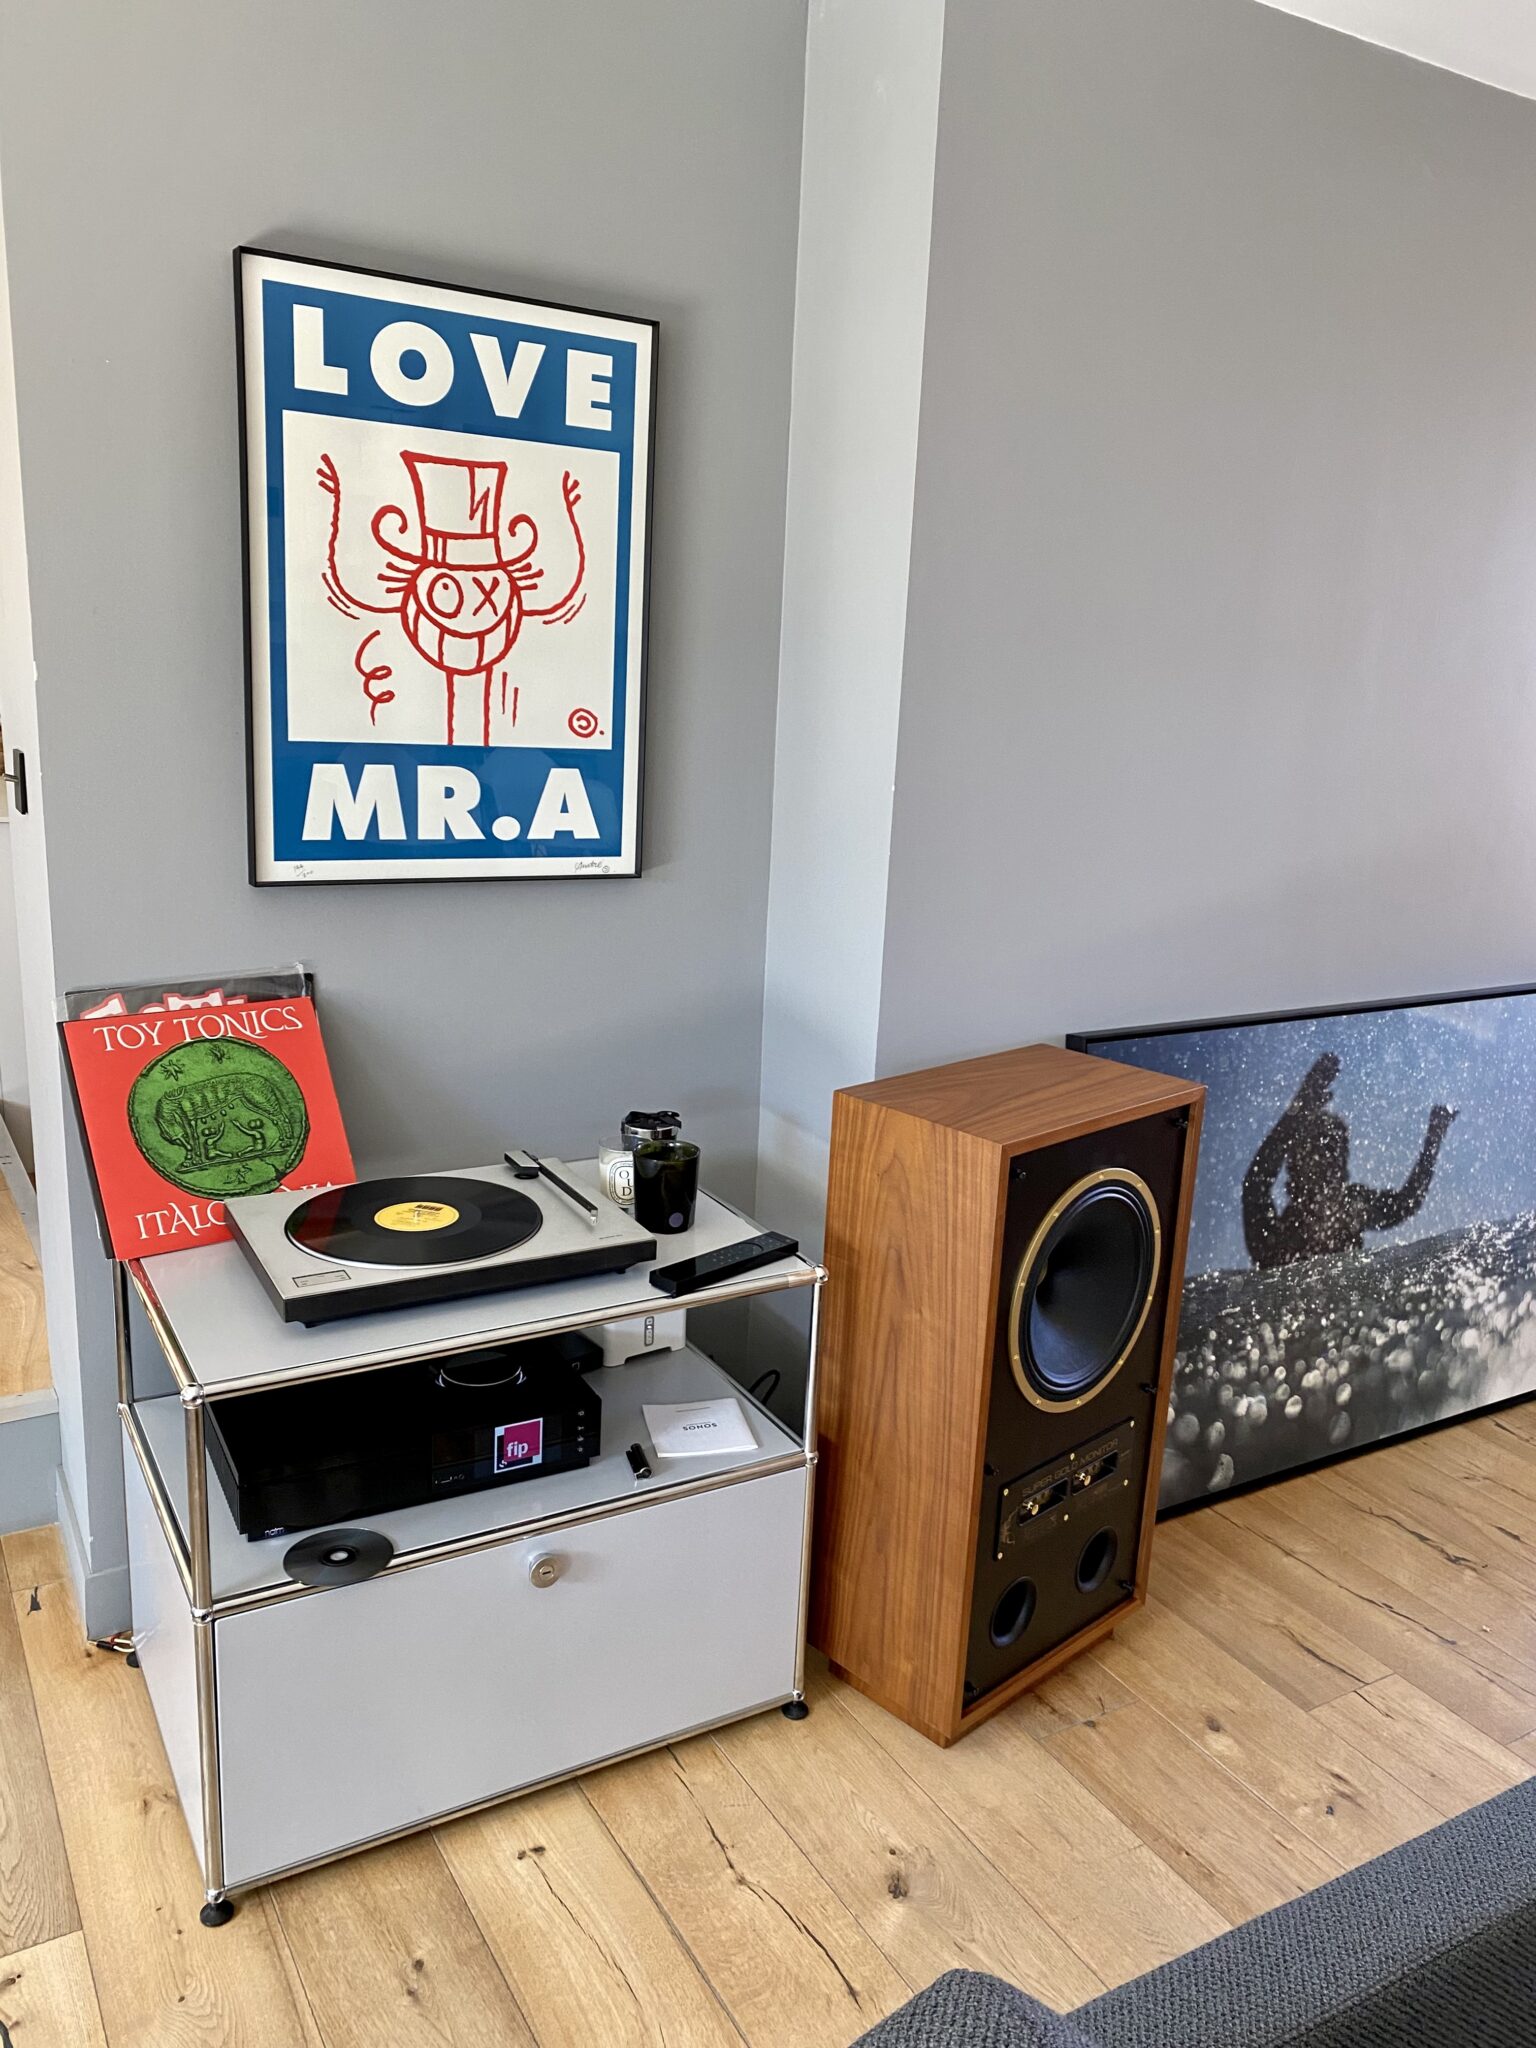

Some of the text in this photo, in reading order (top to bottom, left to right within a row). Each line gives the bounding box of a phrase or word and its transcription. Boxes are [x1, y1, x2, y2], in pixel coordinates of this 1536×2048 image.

[291, 303, 614, 432] LOVE
[301, 763, 600, 841] MR.A
[93, 1006, 304, 1051] TOY TONICS
[682, 1422, 718, 1431] SONOS
[506, 1441, 529, 1458] fip
[1079, 1438, 1119, 1466] MONITOR
